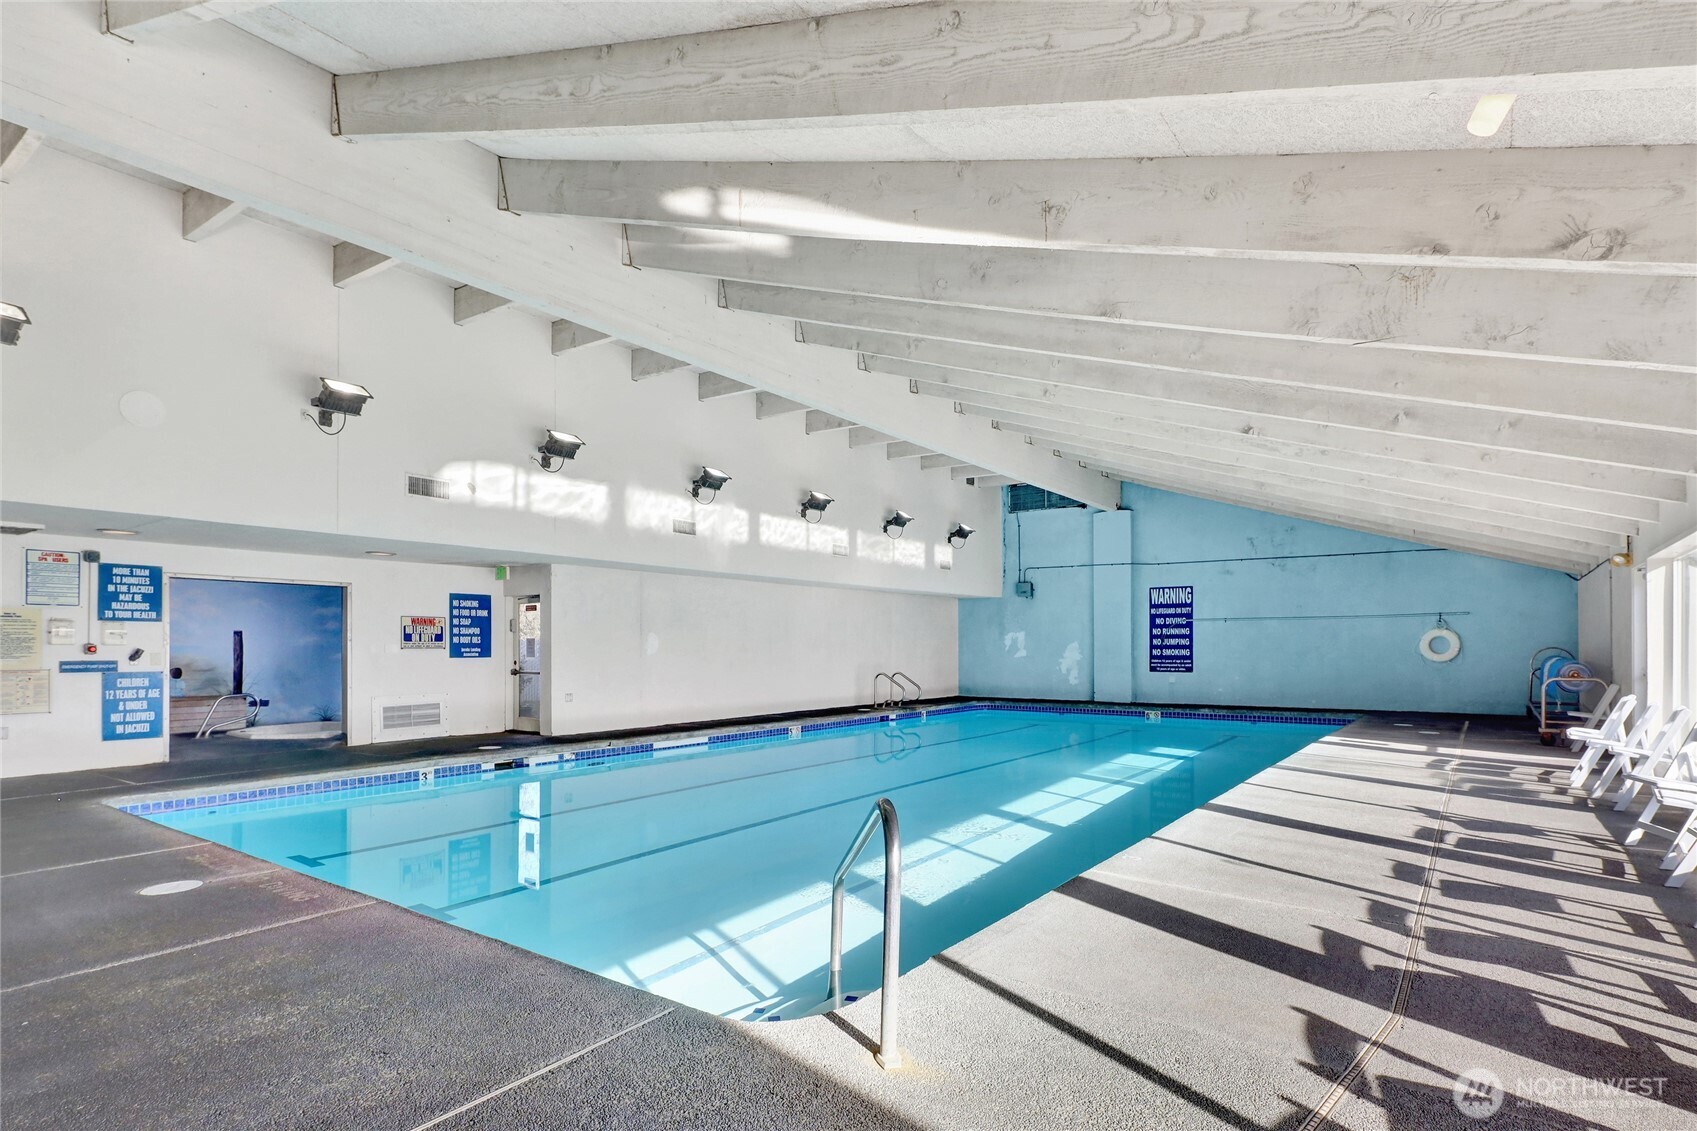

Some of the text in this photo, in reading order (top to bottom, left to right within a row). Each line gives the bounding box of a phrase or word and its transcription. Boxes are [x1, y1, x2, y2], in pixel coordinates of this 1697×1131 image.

[112, 567, 131, 575] MORE
[112, 576, 150, 584] 10 MINUTES
[116, 584, 129, 592] THE
[130, 586, 154, 594] JACUZZI
[1150, 588, 1192, 604] WARNING
[112, 602, 150, 610] HAZARDOUS
[411, 618, 436, 626] WARNING
[406, 626, 442, 634] NO LIFEGUARD
[412, 634, 436, 642] ON DUTY
[117, 678, 149, 687] CHILDREN
[106, 688, 160, 699] 12 YEARS OF AGE
[118, 701, 148, 710] & UNDER
[110, 712, 155, 722] NOT ALLOWED
[116, 723, 150, 734] IN JACUZZI
[421, 772, 428, 780] 3
